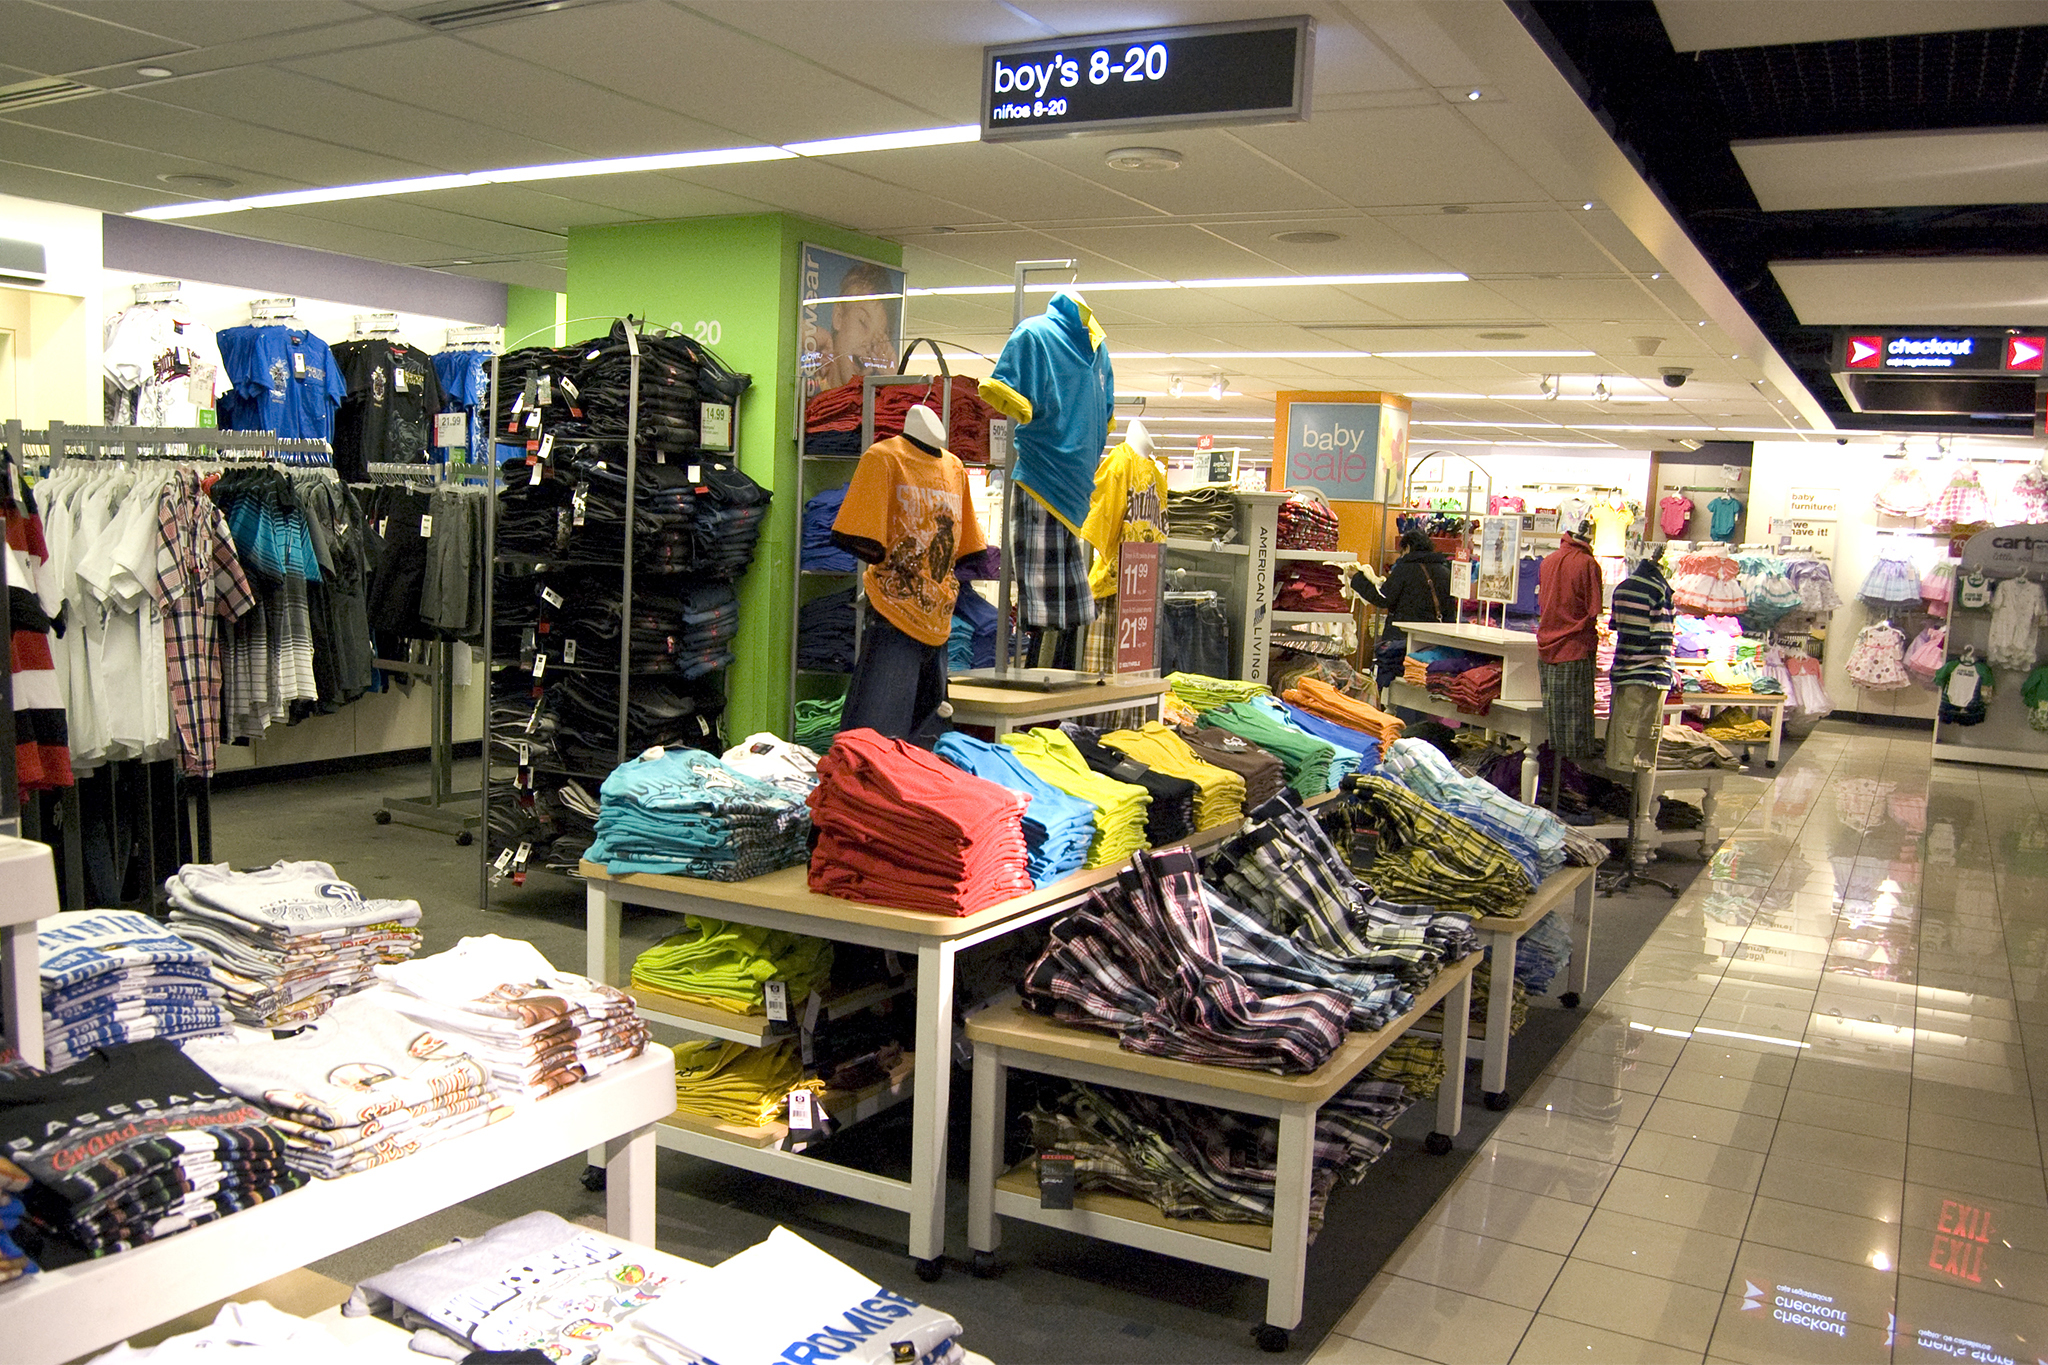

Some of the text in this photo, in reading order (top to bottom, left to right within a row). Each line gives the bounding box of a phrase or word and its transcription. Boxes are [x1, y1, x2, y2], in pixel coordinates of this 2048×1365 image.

[994, 42, 1169, 98] boy's 8-20
[993, 97, 1068, 120] niños 8-20
[1887, 336, 1974, 356] checkout
[441, 416, 462, 427] 21.99
[706, 407, 725, 421] 14.99
[1303, 422, 1365, 454] baby
[1291, 447, 1367, 484] sale
[1791, 493, 1815, 502] baby
[1791, 502, 1837, 511] furniture!
[1817, 527, 1829, 537] it!
[1251, 526, 1269, 681] AMERICAN LIVING
